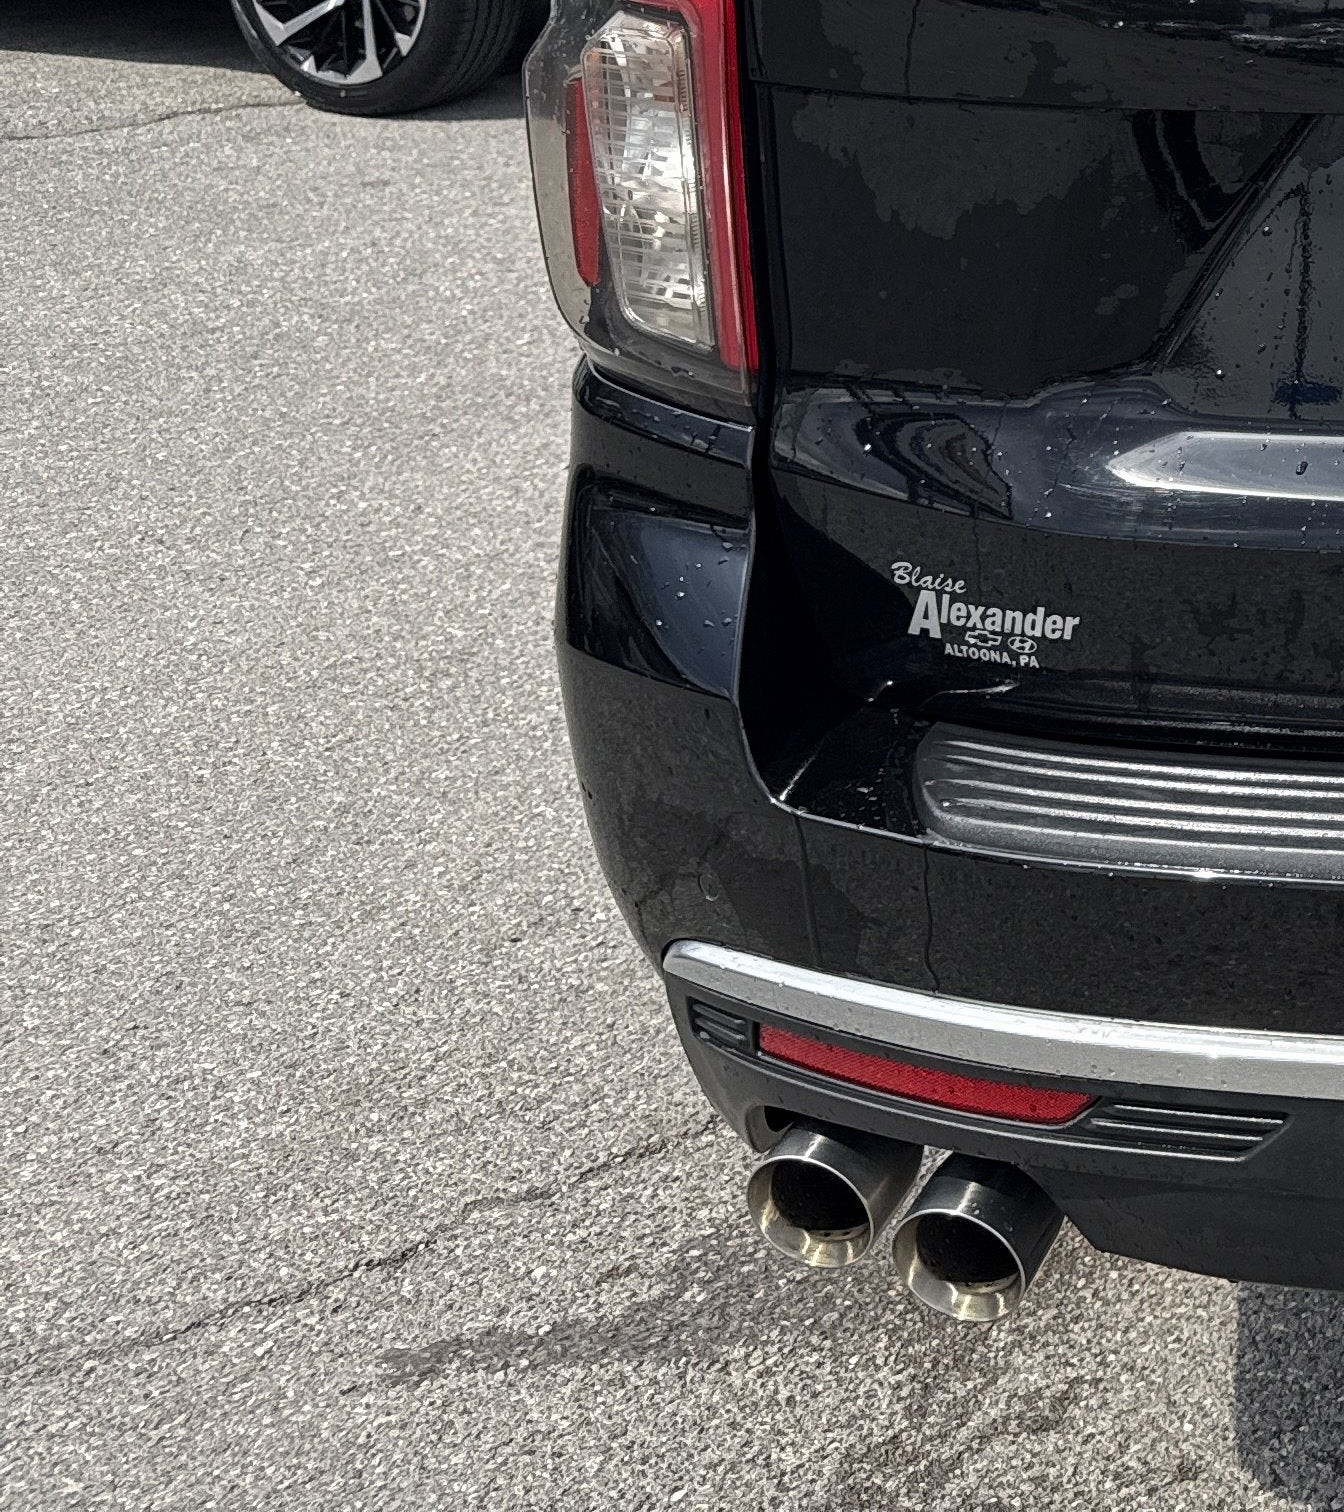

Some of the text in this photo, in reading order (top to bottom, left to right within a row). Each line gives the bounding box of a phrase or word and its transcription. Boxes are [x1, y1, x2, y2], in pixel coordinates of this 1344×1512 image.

[891, 562, 967, 594] Blaise
[907, 590, 1081, 640] Alexander
[944, 643, 1039, 668] ALTOONA, PA
